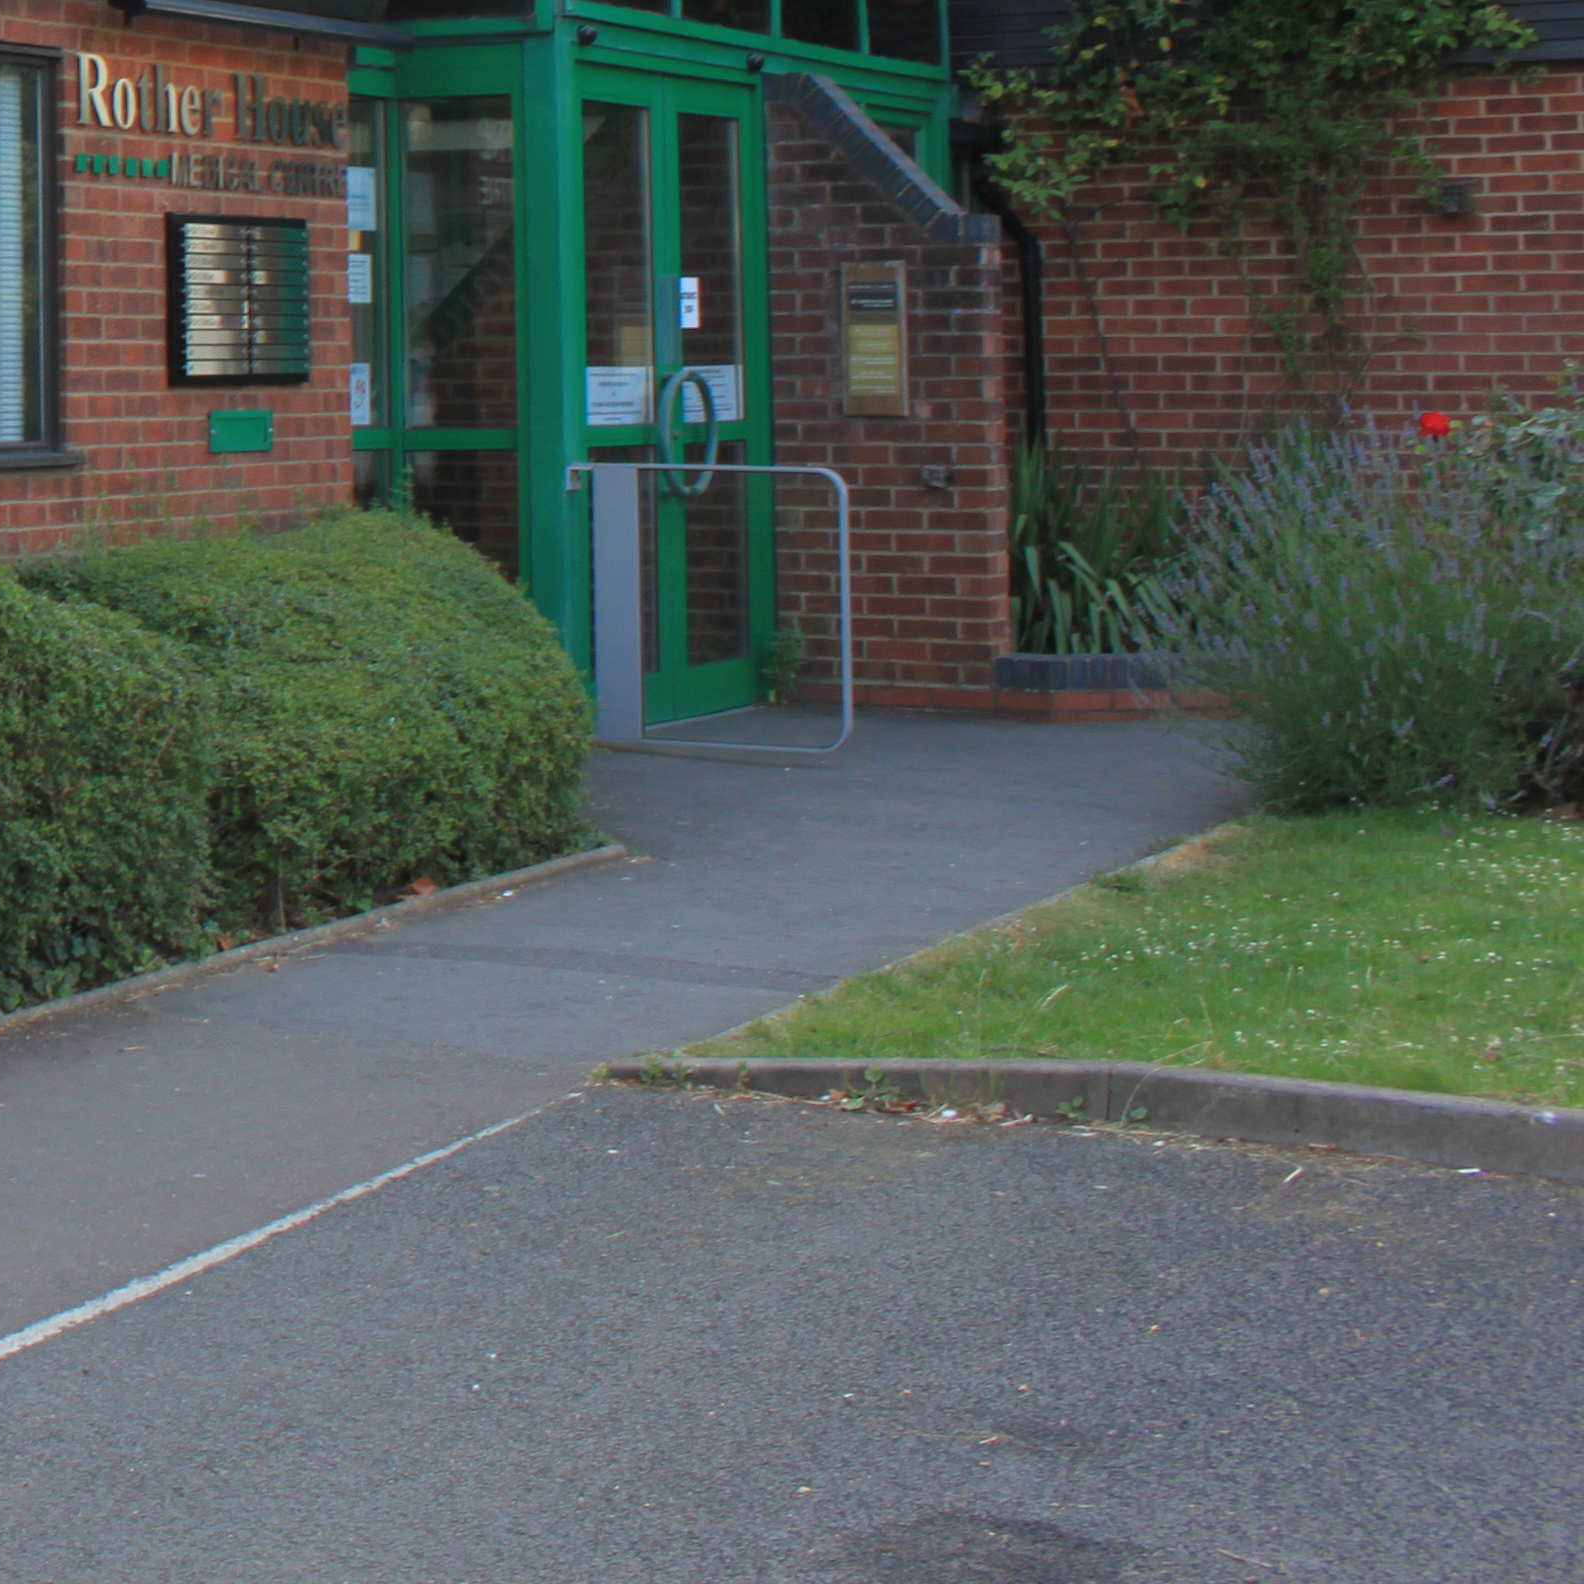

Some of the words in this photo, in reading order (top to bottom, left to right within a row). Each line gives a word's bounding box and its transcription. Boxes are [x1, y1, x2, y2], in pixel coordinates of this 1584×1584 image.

[76, 52, 224, 137] Rother
[232, 71, 348, 150] House
[171, 152, 264, 193] MEDICAL
[271, 159, 347, 197] CENTRE
